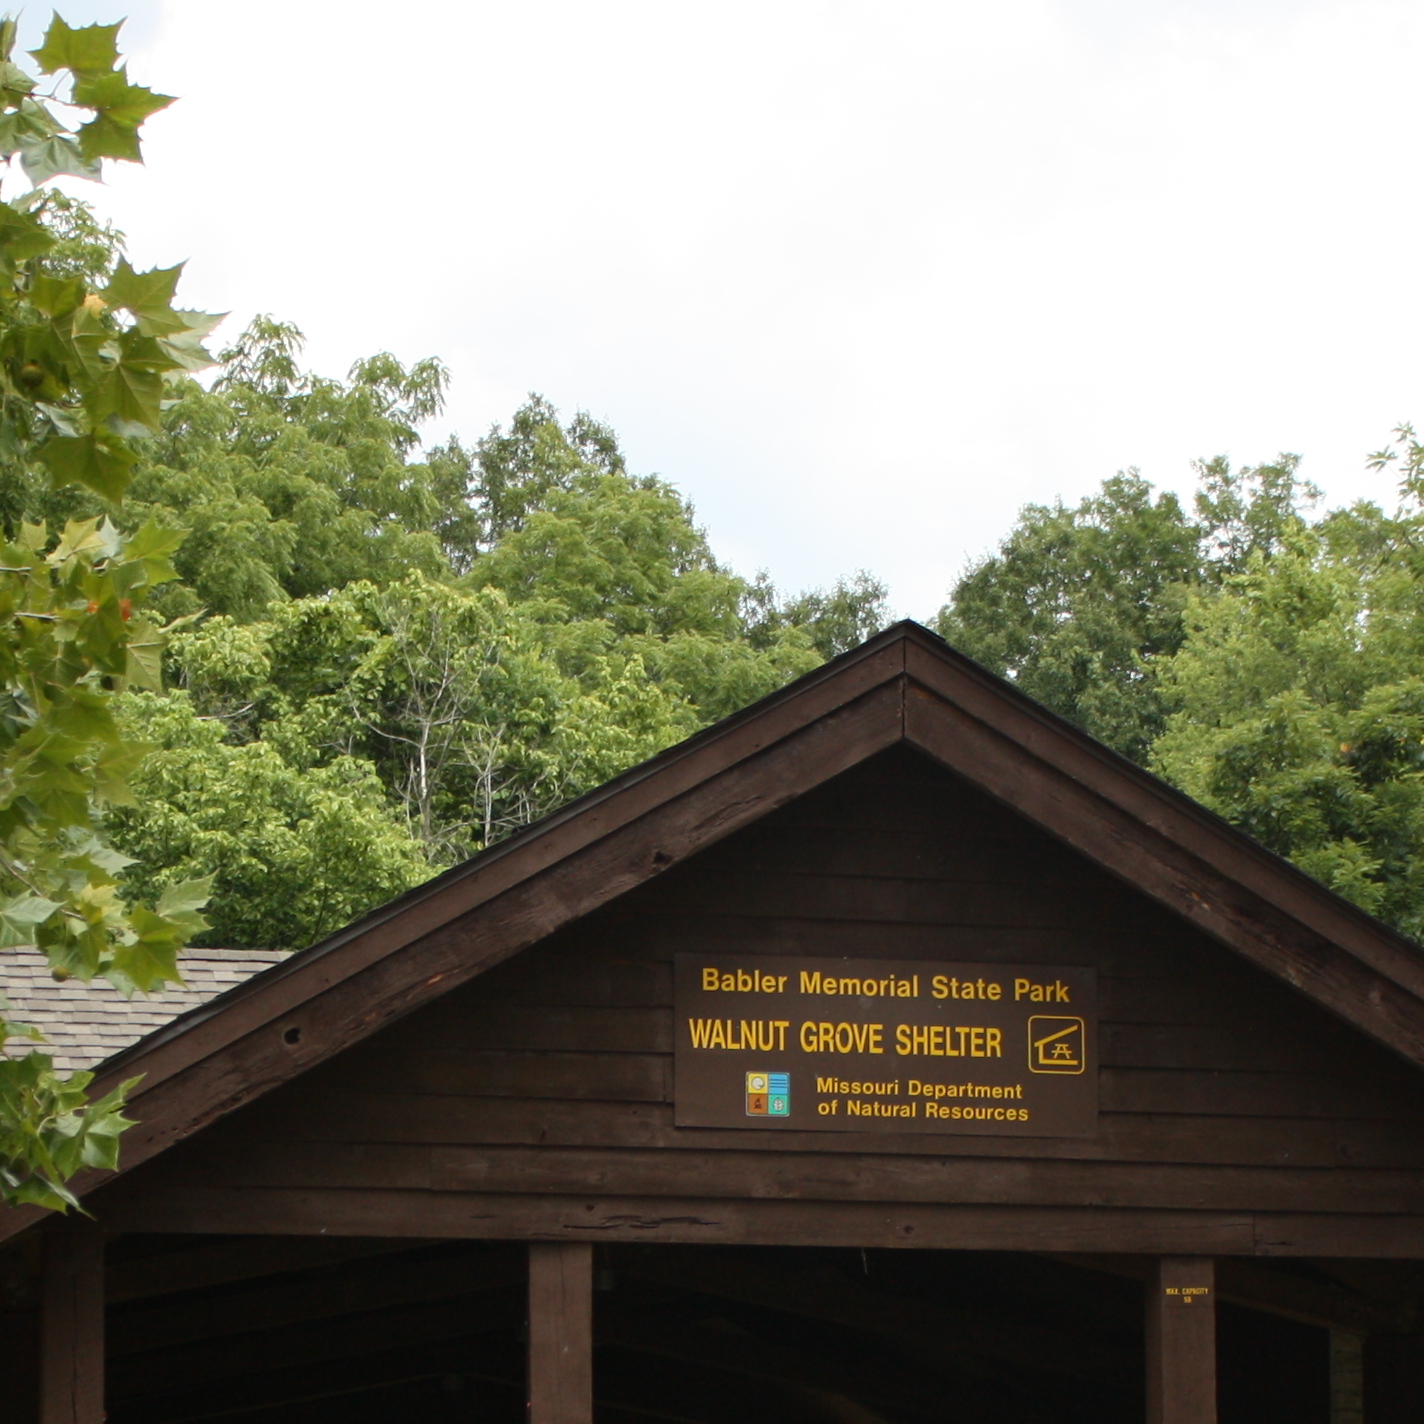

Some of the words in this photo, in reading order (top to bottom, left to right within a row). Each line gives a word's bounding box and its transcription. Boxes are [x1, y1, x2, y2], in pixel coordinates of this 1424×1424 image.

[701, 967, 789, 994] Babler
[799, 970, 920, 998] Memorial
[931, 974, 1003, 1001] State
[1014, 978, 1071, 1003] Park
[688, 1018, 791, 1052] WALNUT
[799, 1021, 885, 1054] GROVE
[895, 1024, 1003, 1058] SHELTER
[816, 1076, 900, 1096] Missouri
[907, 1079, 1023, 1099] Department
[817, 1099, 840, 1116] of
[846, 1100, 917, 1118] Natural
[924, 1101, 1030, 1122] Resources
[1181, 1287, 1210, 1296] CAPACITY
